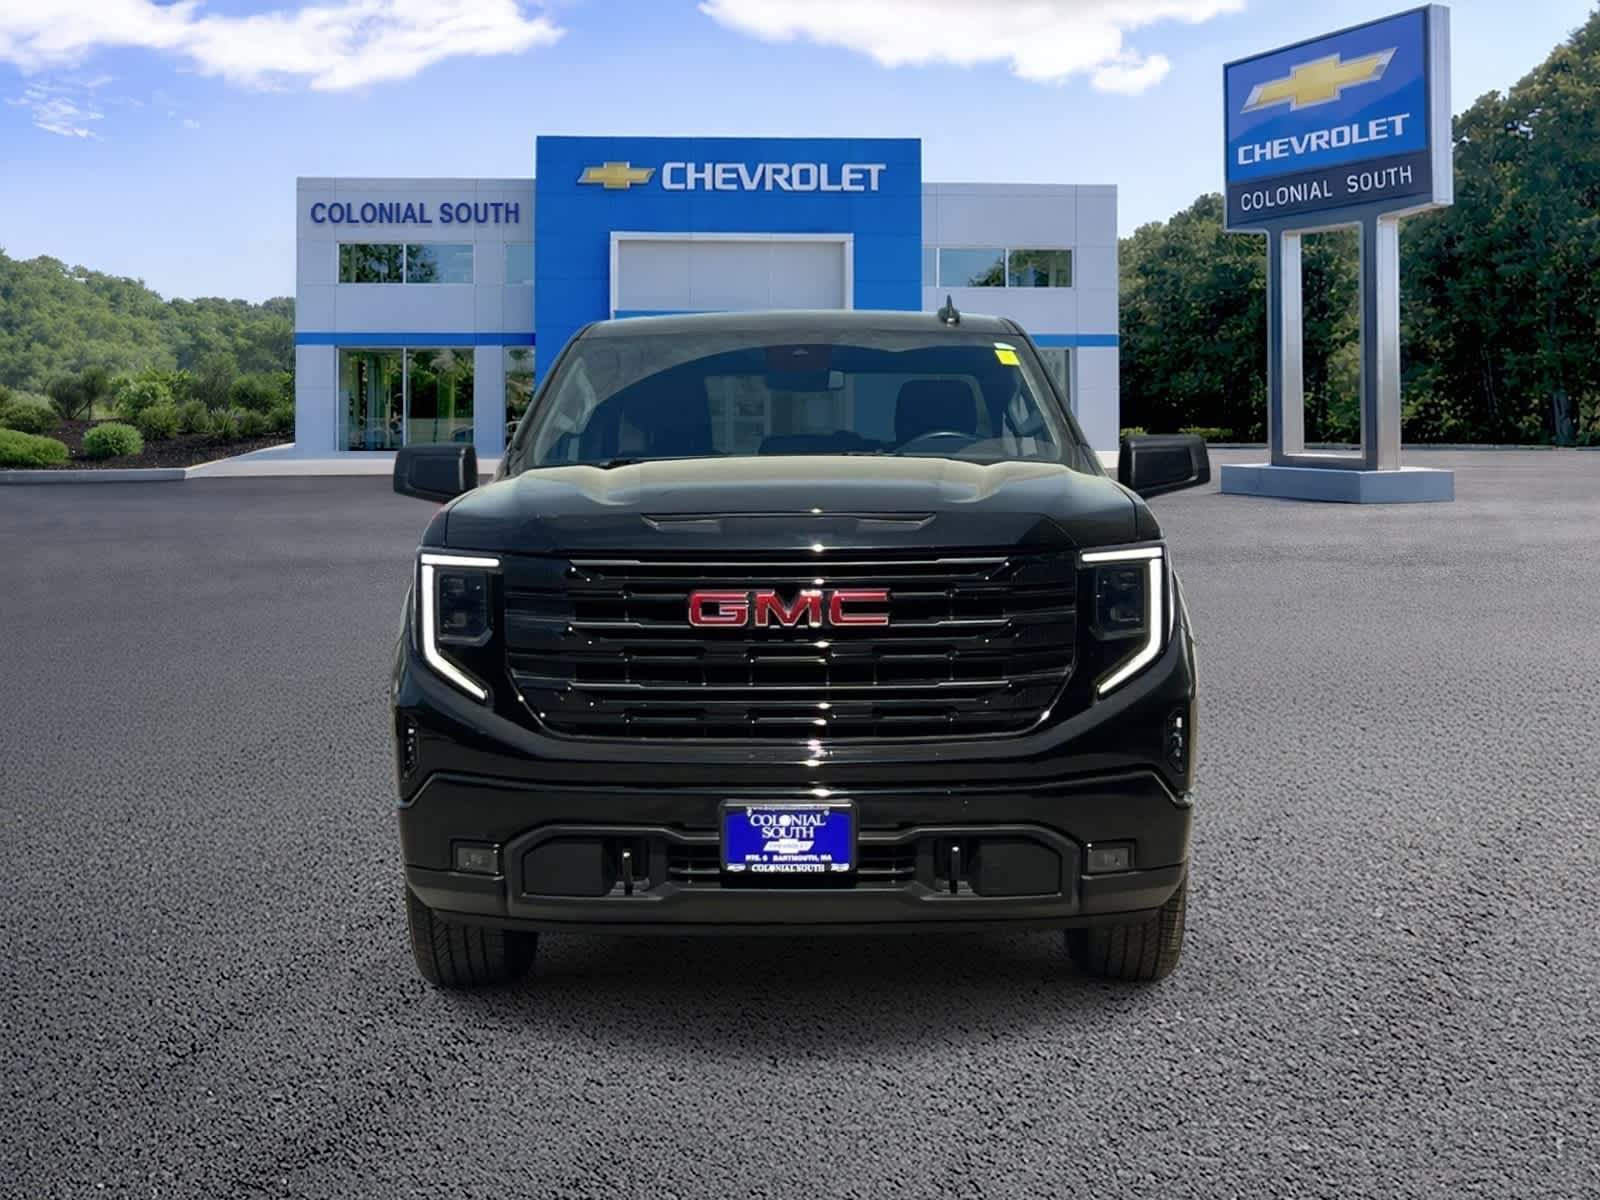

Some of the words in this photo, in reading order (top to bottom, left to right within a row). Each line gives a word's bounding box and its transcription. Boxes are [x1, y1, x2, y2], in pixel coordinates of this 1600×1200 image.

[1237, 113, 1411, 165] CHEVROLET
[661, 161, 887, 192] CHEVROLET
[1240, 179, 1333, 211] COLONIAL
[1346, 165, 1413, 193] SOUTH
[310, 202, 433, 224] COLONIAL
[439, 202, 520, 224] SOUTH
[688, 589, 890, 627] GMC
[750, 814, 826, 826] COLONIAL
[762, 827, 814, 838] SOUTH
